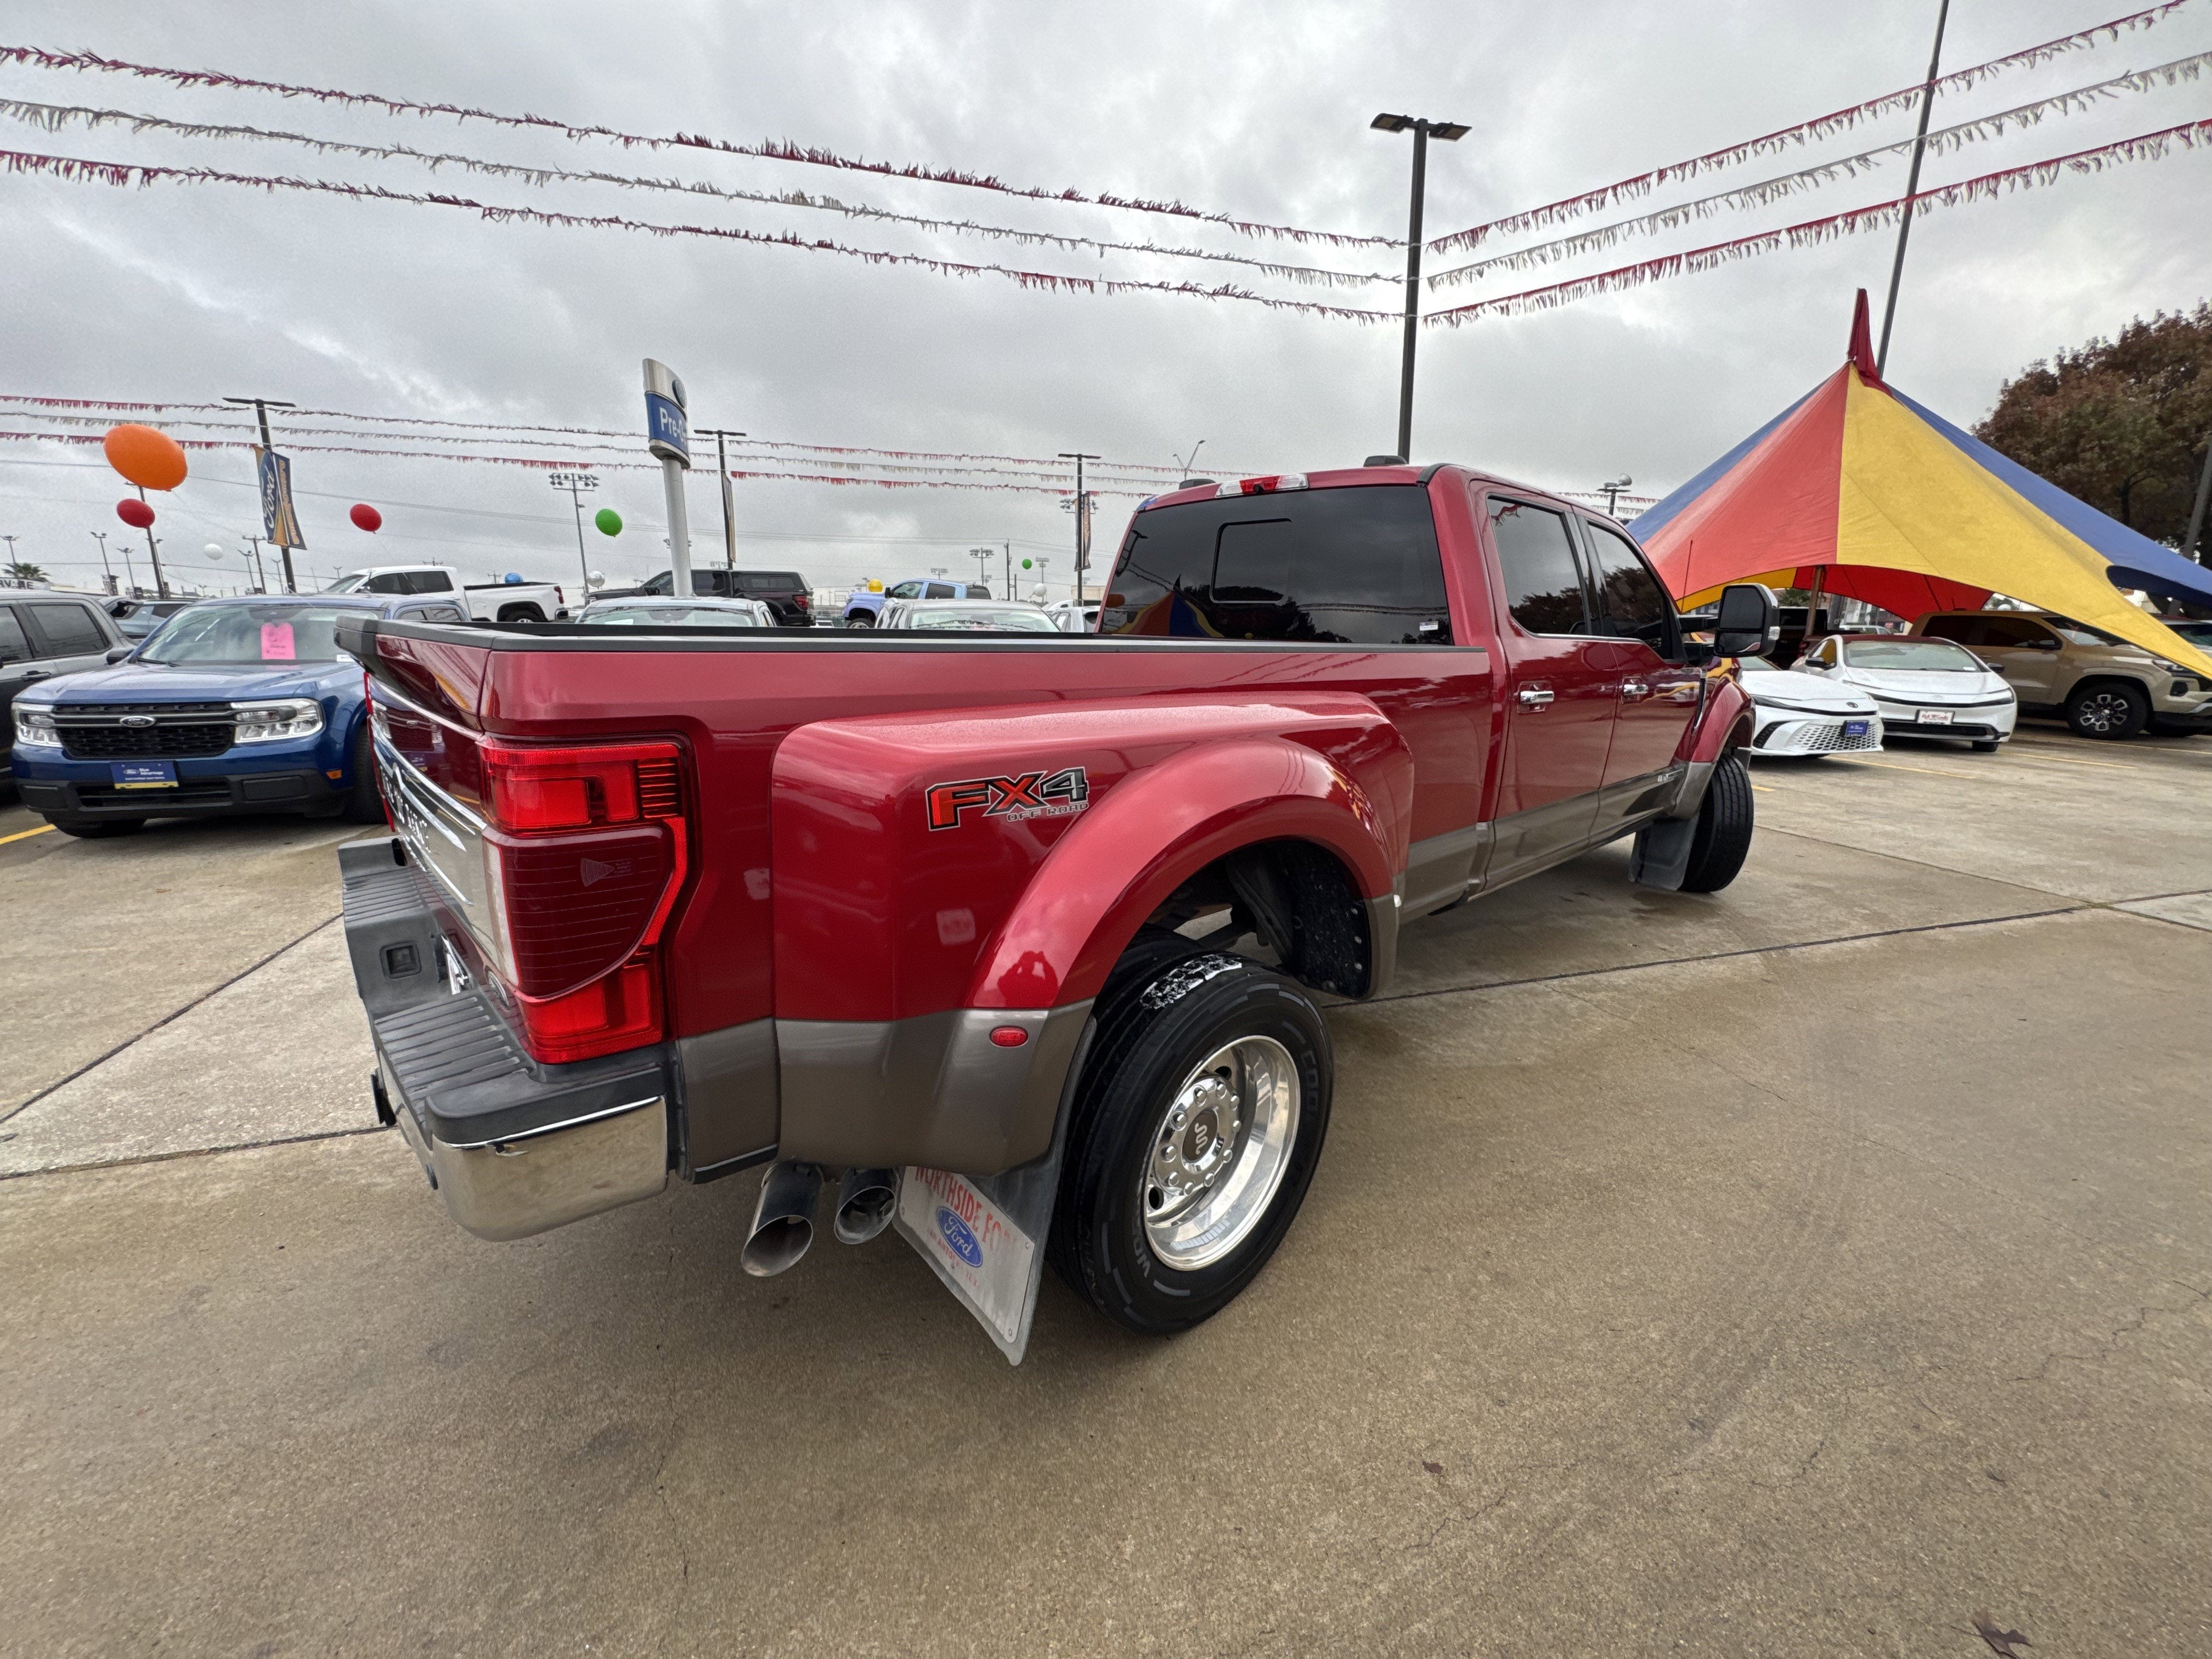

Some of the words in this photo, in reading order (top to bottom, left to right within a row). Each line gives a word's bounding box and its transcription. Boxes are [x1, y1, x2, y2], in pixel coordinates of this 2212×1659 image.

[263, 464, 275, 529] Ford
[925, 766, 1090, 832] FX4
[1006, 809, 1041, 822] OFF
[1046, 802, 1090, 816] ROAD
[915, 1166, 983, 1233] NORTHSIDE
[944, 1216, 973, 1256] Ford
